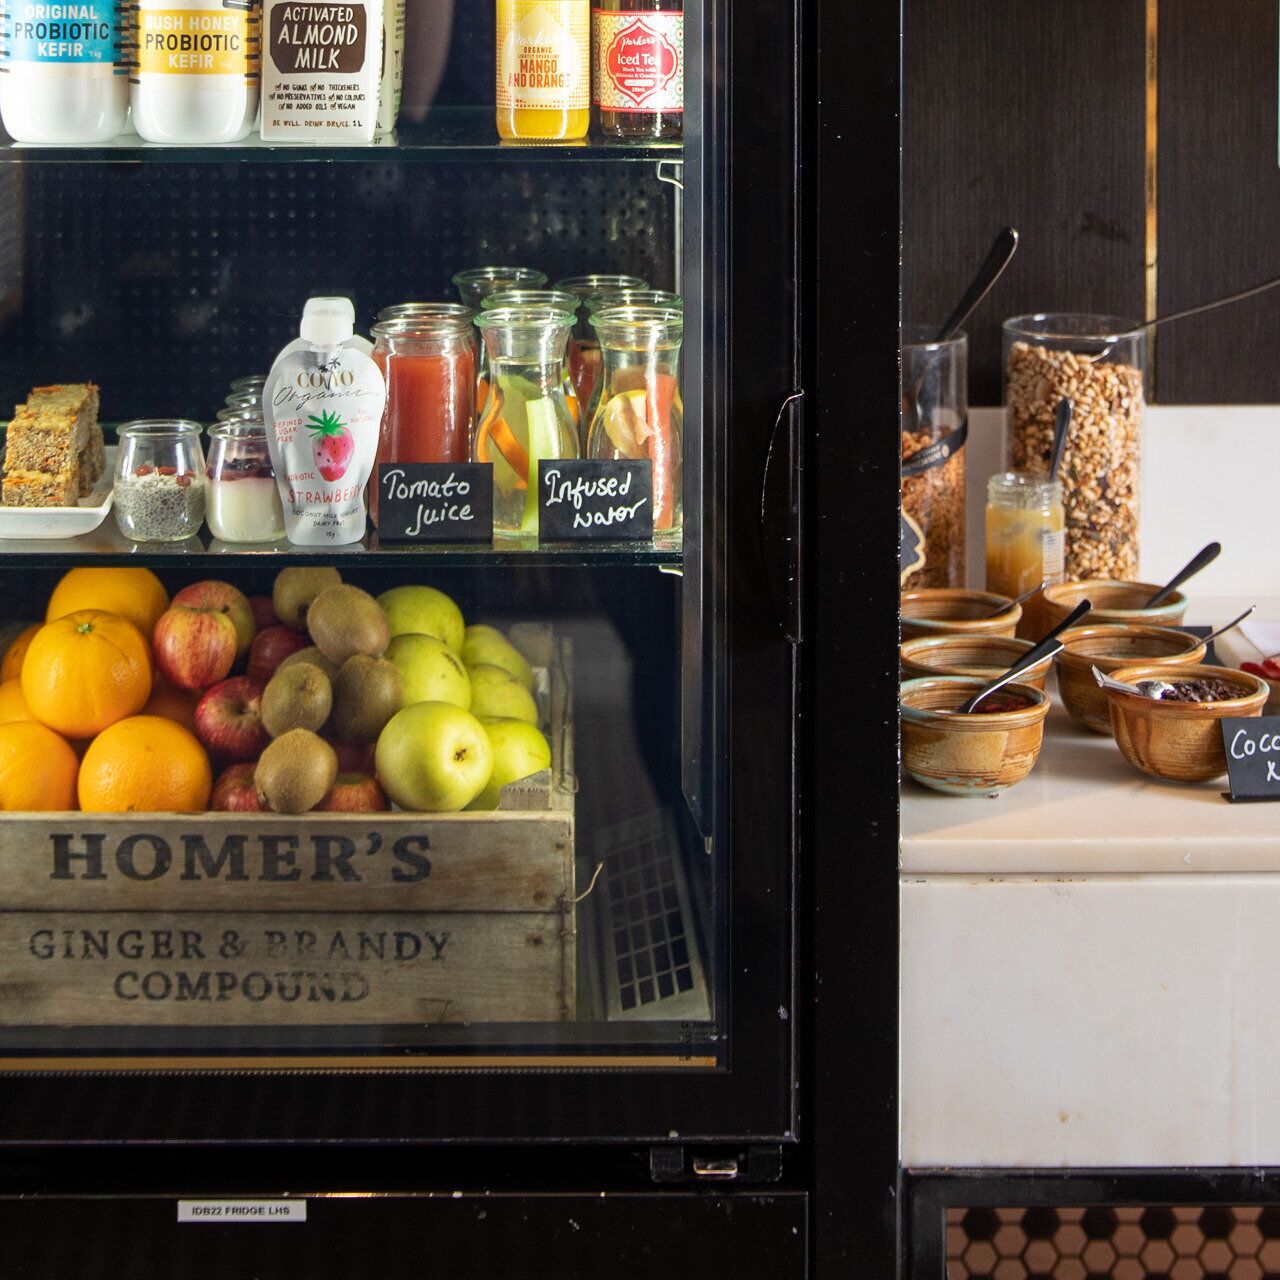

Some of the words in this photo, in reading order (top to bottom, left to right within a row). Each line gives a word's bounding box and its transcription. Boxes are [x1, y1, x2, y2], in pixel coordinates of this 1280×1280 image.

[24, 5, 98, 19] ORIGINAL
[283, 6, 354, 22] ACTIVATED
[15, 22, 109, 40] PROBIOTIC
[145, 15, 183, 31] BUSH
[189, 16, 239, 31] HONEY
[145, 34, 239, 51] PROBIOTIC
[278, 24, 358, 45] ALMOND
[38, 42, 83, 57] KEFIR
[523, 46, 553, 54] ORGANIC
[168, 54, 214, 69] KEFIR
[294, 48, 340, 69] MILK
[520, 59, 557, 74] MANGO
[617, 53, 640, 65] Iced
[508, 73, 527, 88] AND
[285, 93, 326, 101] PRESERVATIVES
[274, 386, 379, 411] Organic
[273, 418, 303, 430] REFINED
[383, 470, 471, 499] Tomato
[545, 469, 632, 509] Infused
[288, 483, 362, 504] STRAWBERRY
[292, 508, 321, 518] COCONUT
[49, 832, 432, 884] HOMER'S
[29, 929, 206, 961] GINGER
[219, 929, 249, 959] &
[265, 931, 453, 962] BRANDY
[114, 972, 370, 1003] COMPOUND
[192, 1206, 223, 1216] IDB22
[225, 1206, 266, 1216] FRIDGE
[268, 1206, 290, 1216] LHS
